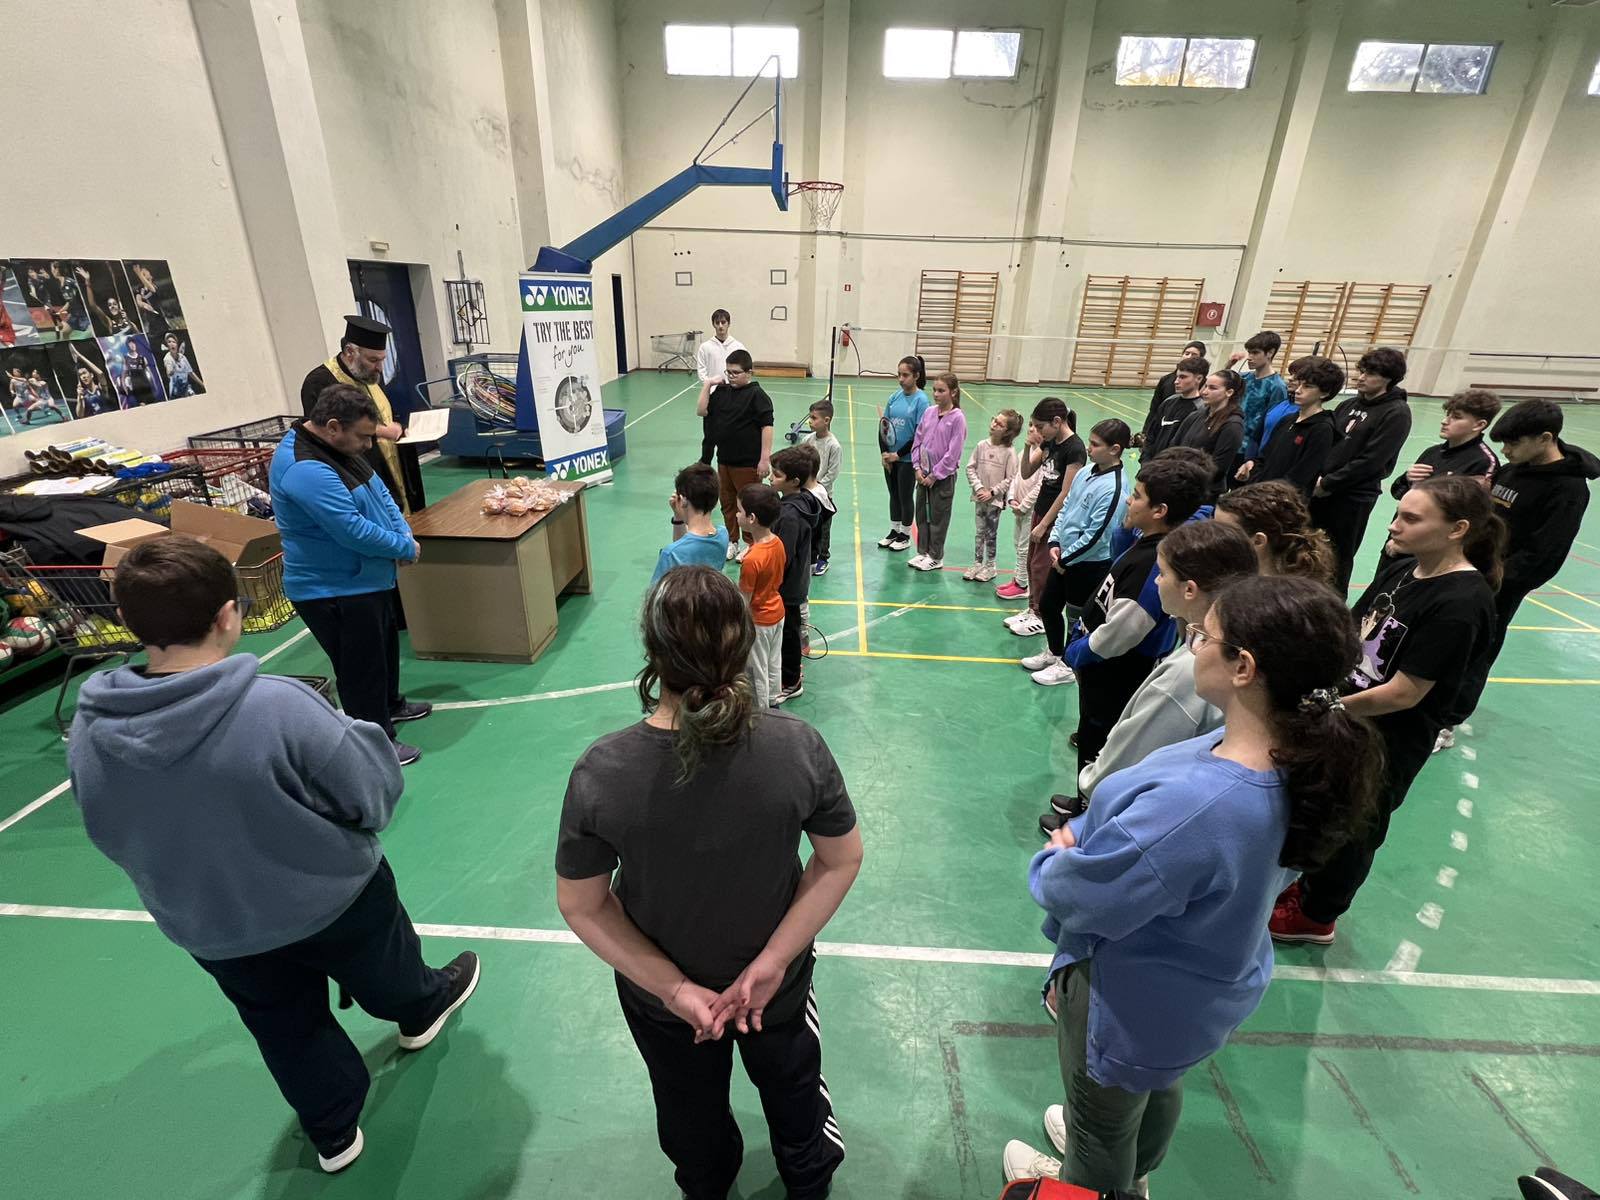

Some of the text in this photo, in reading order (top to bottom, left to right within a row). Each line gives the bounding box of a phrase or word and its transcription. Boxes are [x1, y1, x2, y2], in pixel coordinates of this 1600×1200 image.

[551, 286, 591, 306] YONEX
[533, 320, 593, 343] TRY THE BEST
[553, 344, 584, 369] for you
[573, 450, 608, 475] YONEX
